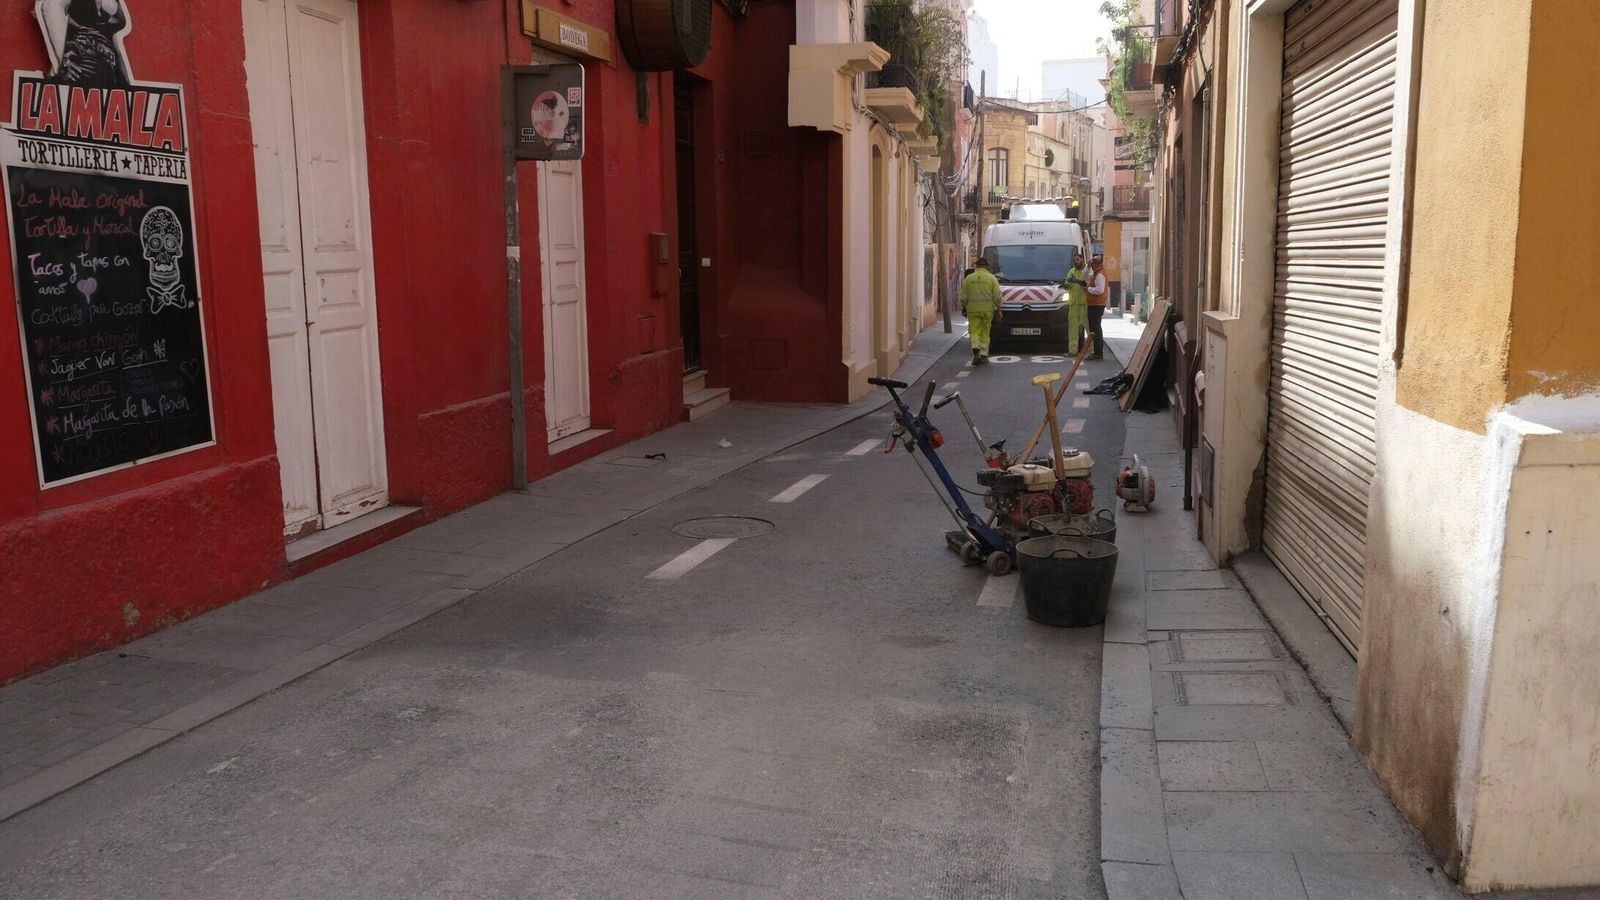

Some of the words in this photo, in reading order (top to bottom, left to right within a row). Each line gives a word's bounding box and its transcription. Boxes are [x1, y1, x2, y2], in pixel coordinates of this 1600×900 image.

[561, 28, 587, 48] BODEGA
[20, 82, 61, 134] LA
[67, 87, 183, 152] MALA
[18, 139, 119, 172] TORTILLERIA
[134, 154, 187, 179] TAPERIA
[17, 184, 42, 207] La
[82, 226, 92, 250] y
[28, 253, 63, 276] Tacos
[70, 261, 78, 283] y
[58, 380, 117, 410] Margarita
[64, 403, 120, 439] Margarita
[122, 396, 138, 418] de
